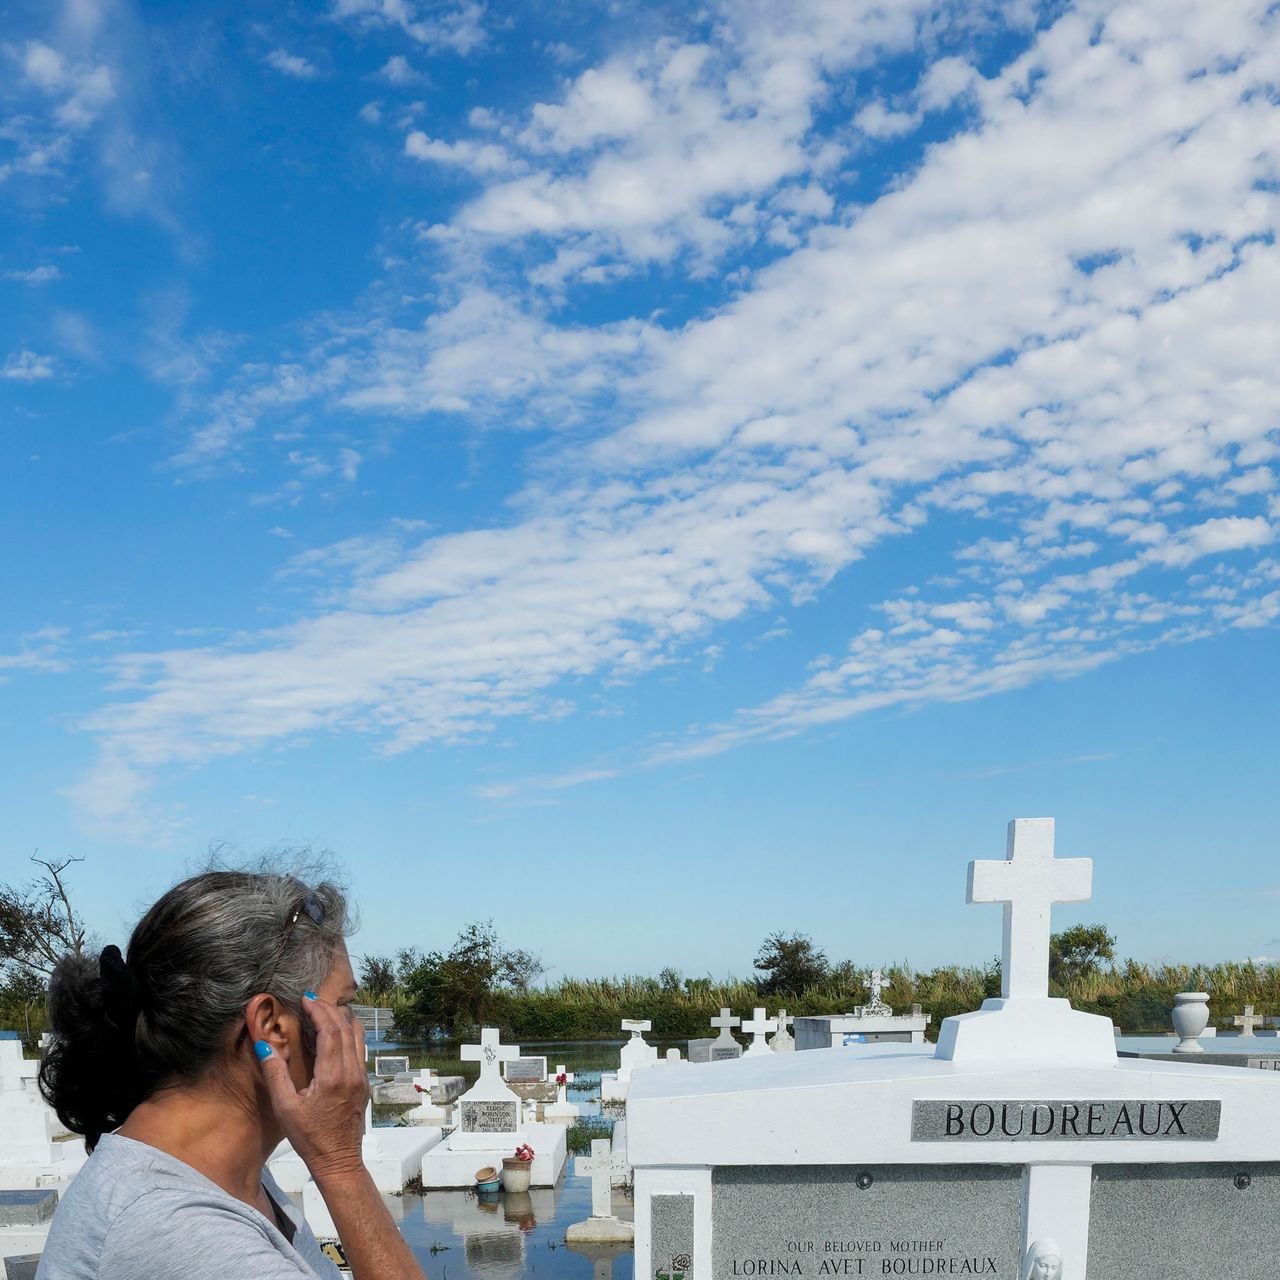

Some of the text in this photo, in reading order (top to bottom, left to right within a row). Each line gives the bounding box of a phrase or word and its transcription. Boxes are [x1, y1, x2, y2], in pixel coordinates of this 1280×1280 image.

[943, 1103, 1189, 1136] BOUDREAUX
[824, 1240, 881, 1252] BELOVED
[733, 1257, 998, 1276] LORINA AVET BOUDREAUX
